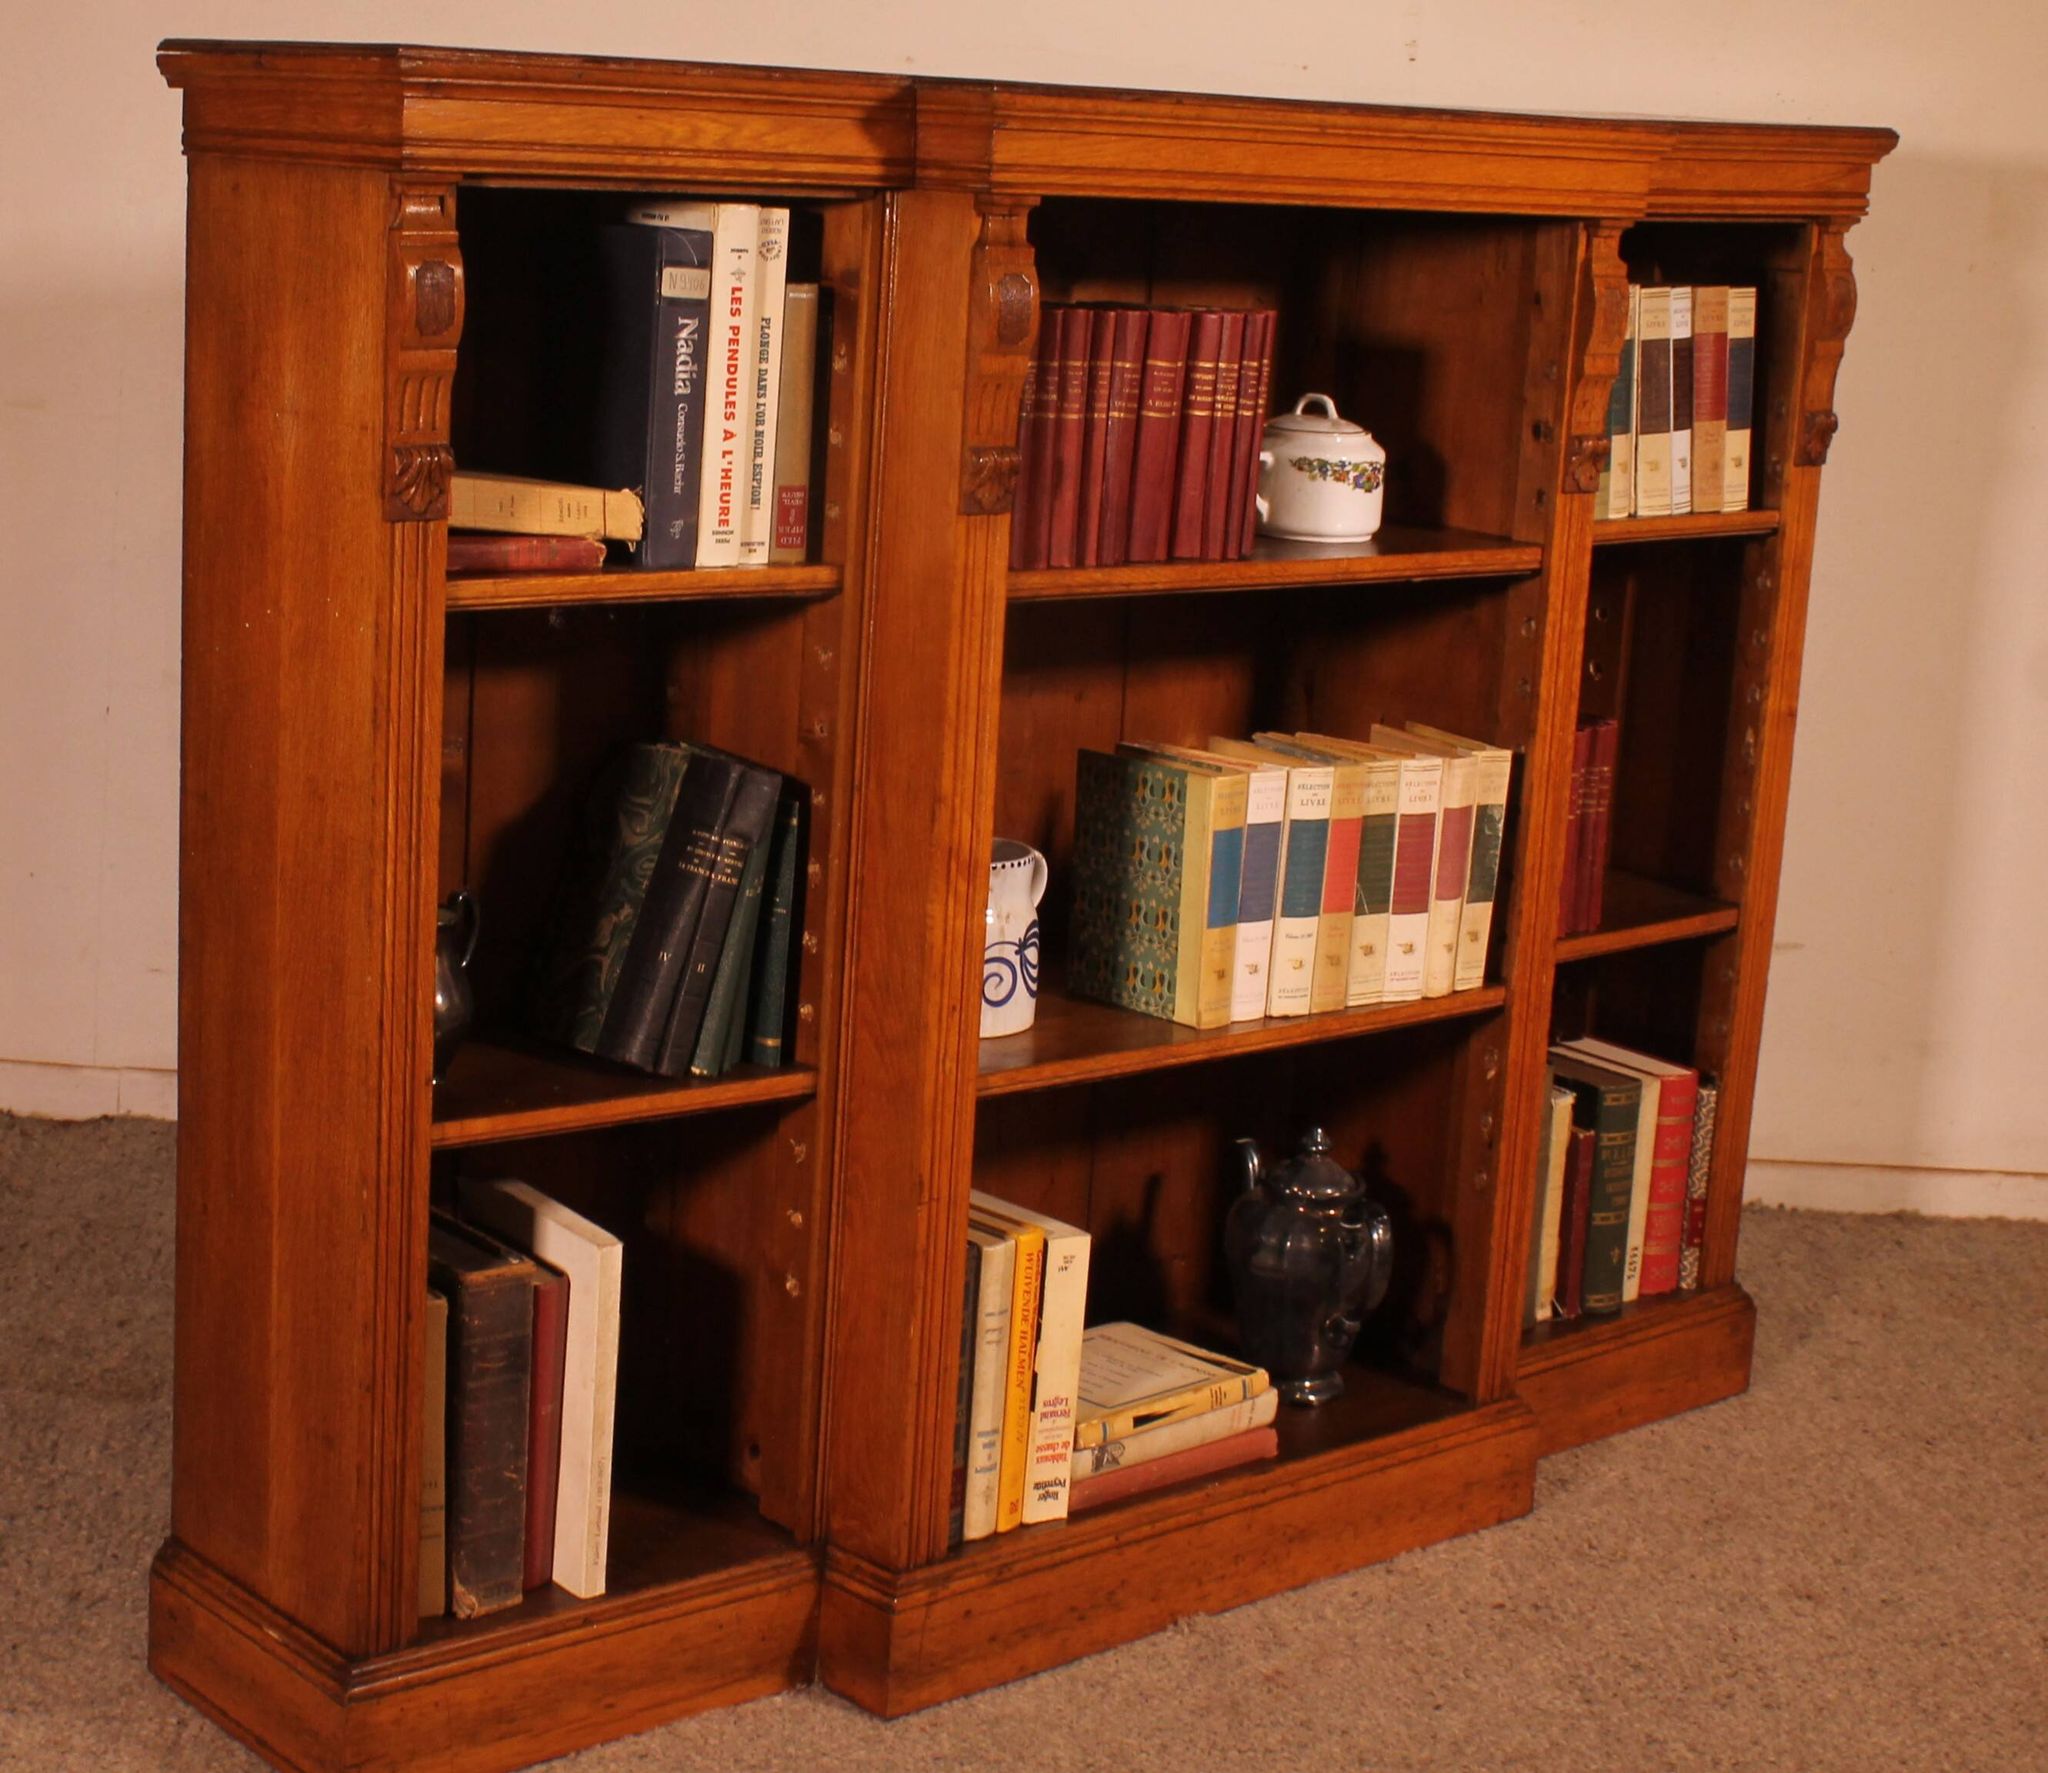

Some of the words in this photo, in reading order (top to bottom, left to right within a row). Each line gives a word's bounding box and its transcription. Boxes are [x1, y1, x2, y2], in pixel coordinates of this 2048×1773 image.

[730, 286, 744, 317] LES
[674, 316, 699, 397] Nadia
[758, 316, 772, 365] PLONGE
[723, 325, 742, 422] PENDULES
[756, 367, 768, 401] DANS
[721, 428, 737, 443] À
[717, 449, 735, 528] L'HEURE
